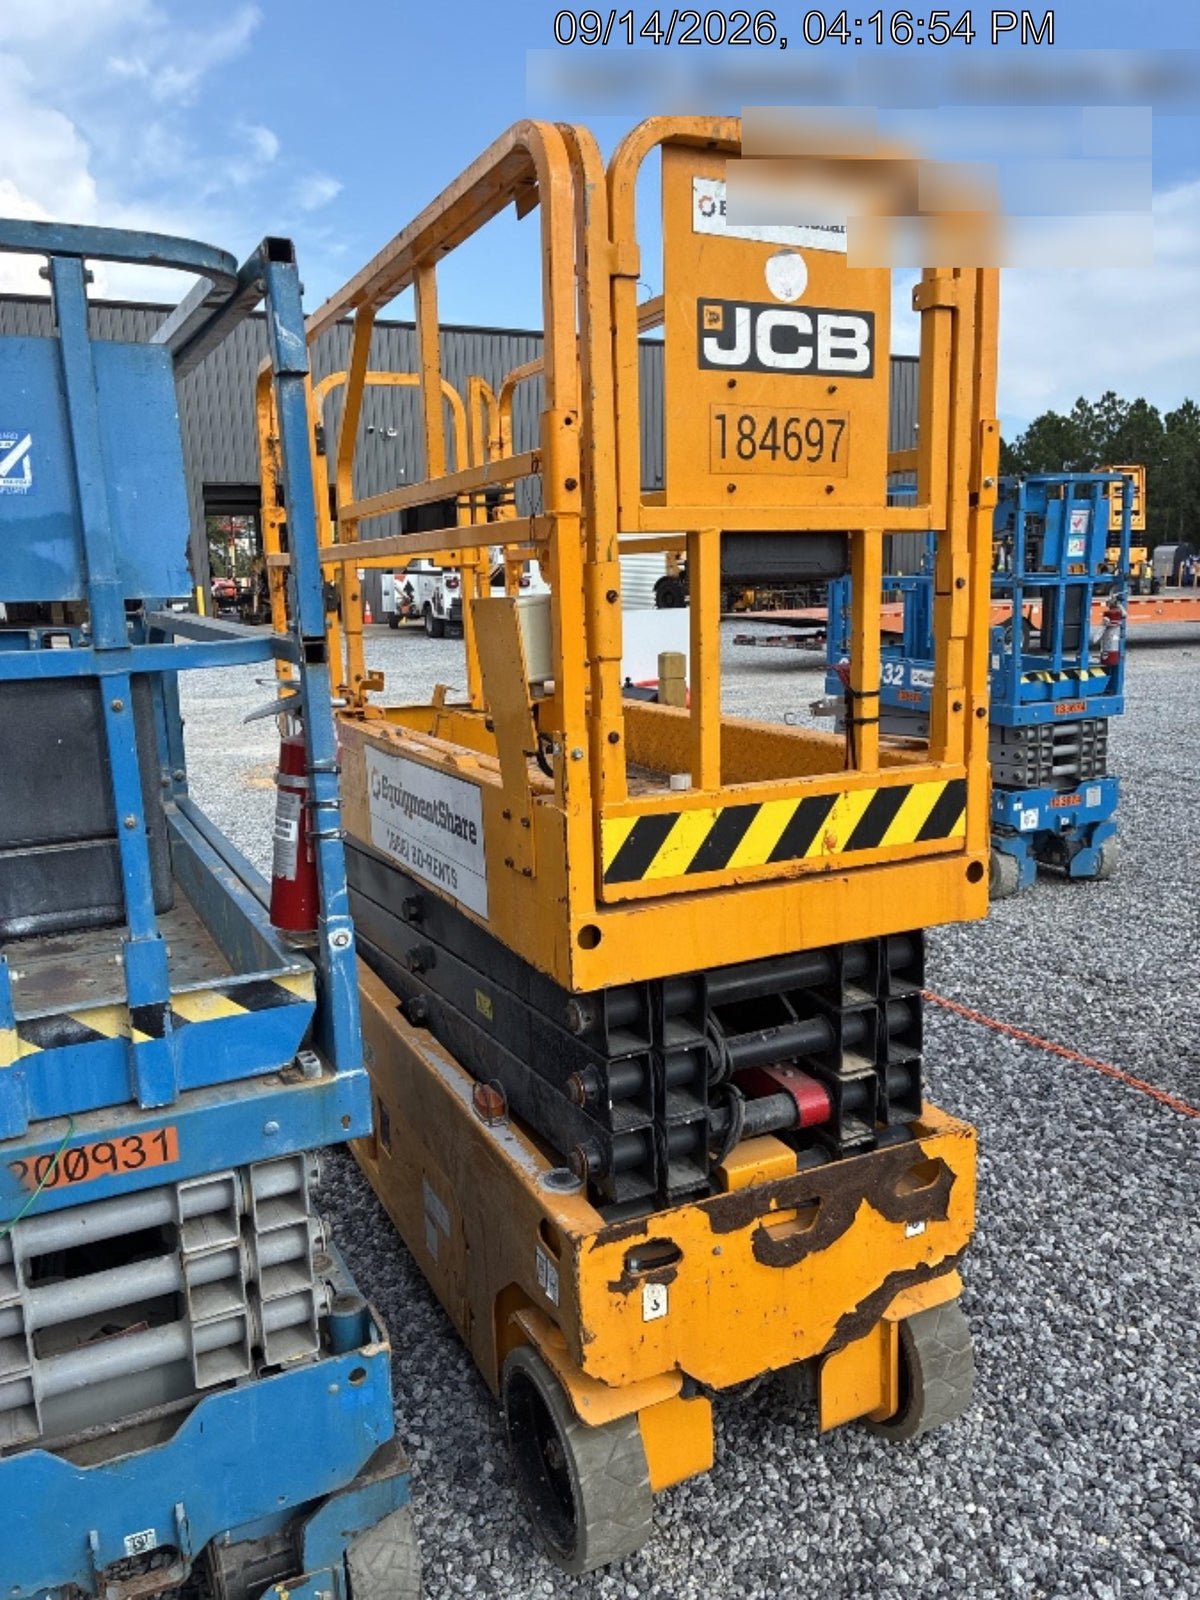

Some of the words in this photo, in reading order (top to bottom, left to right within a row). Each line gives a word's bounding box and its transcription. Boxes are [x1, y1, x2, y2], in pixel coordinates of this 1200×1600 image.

[703, 306, 872, 373] JCB
[714, 413, 847, 463] 184697
[880, 662, 905, 686] 32
[382, 774, 478, 846] EquipmentShare
